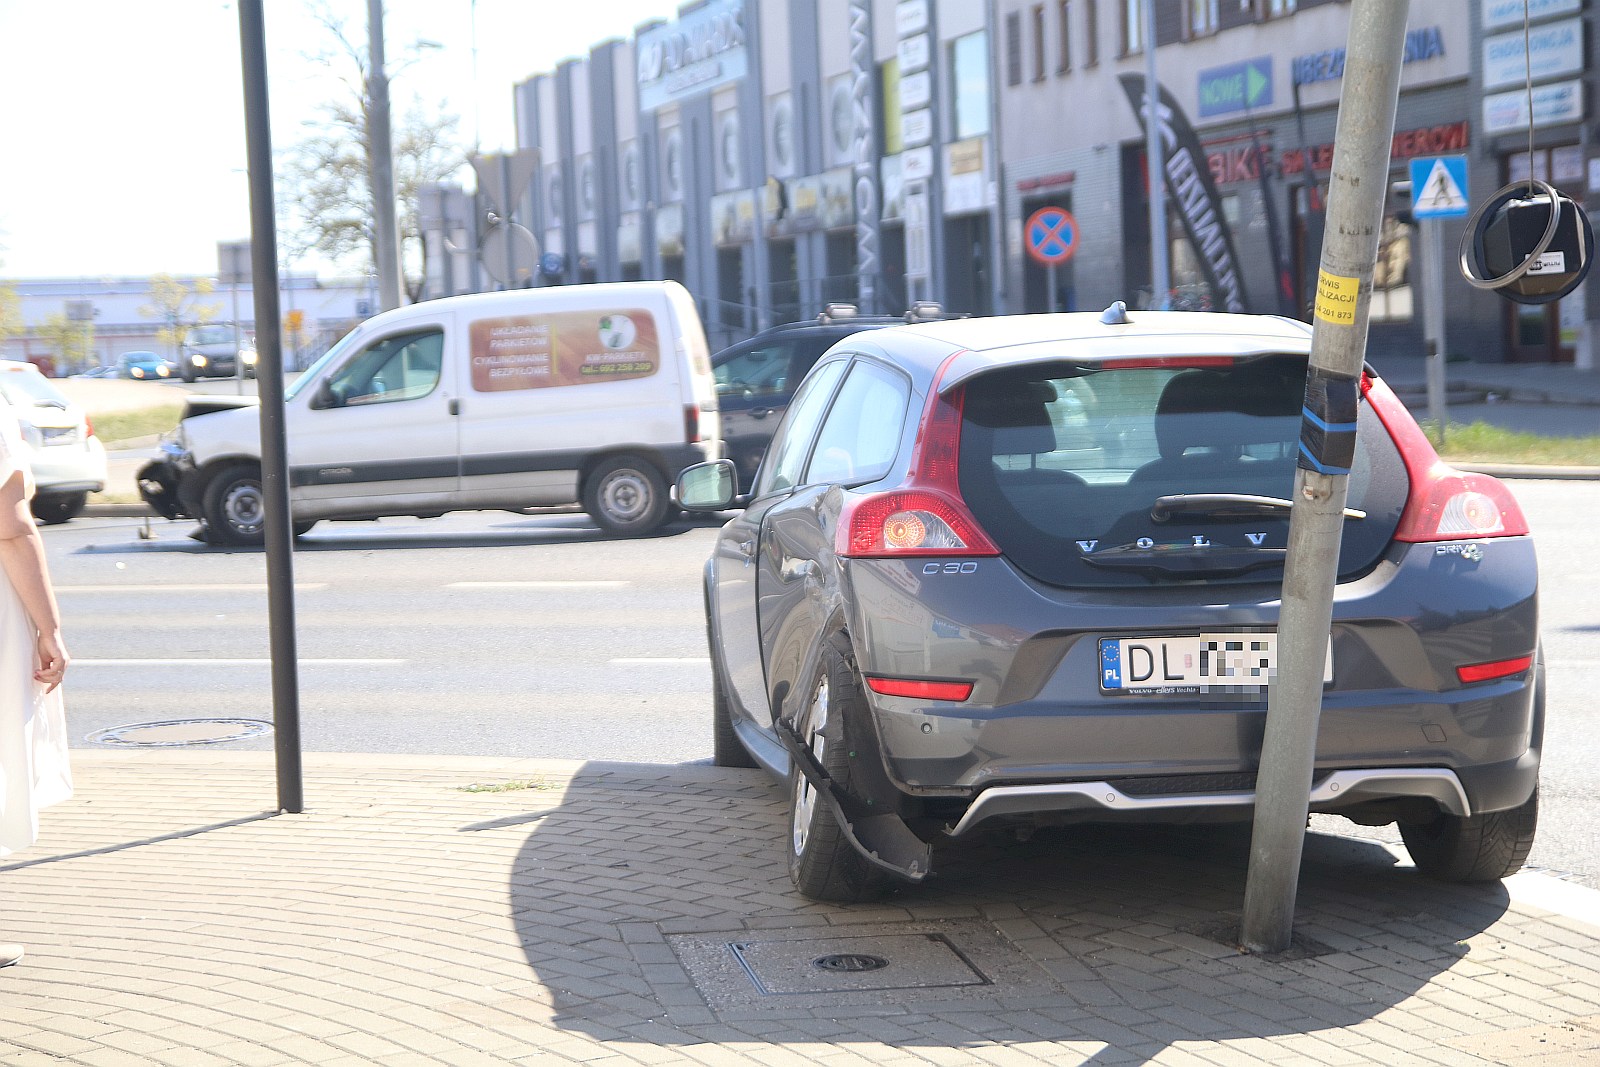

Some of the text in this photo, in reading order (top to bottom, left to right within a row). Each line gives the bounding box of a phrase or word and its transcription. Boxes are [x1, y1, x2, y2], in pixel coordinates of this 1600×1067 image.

[1337, 311, 1352, 319] 873
[1076, 532, 1267, 552] VOLV
[1105, 669, 1120, 680] PL
